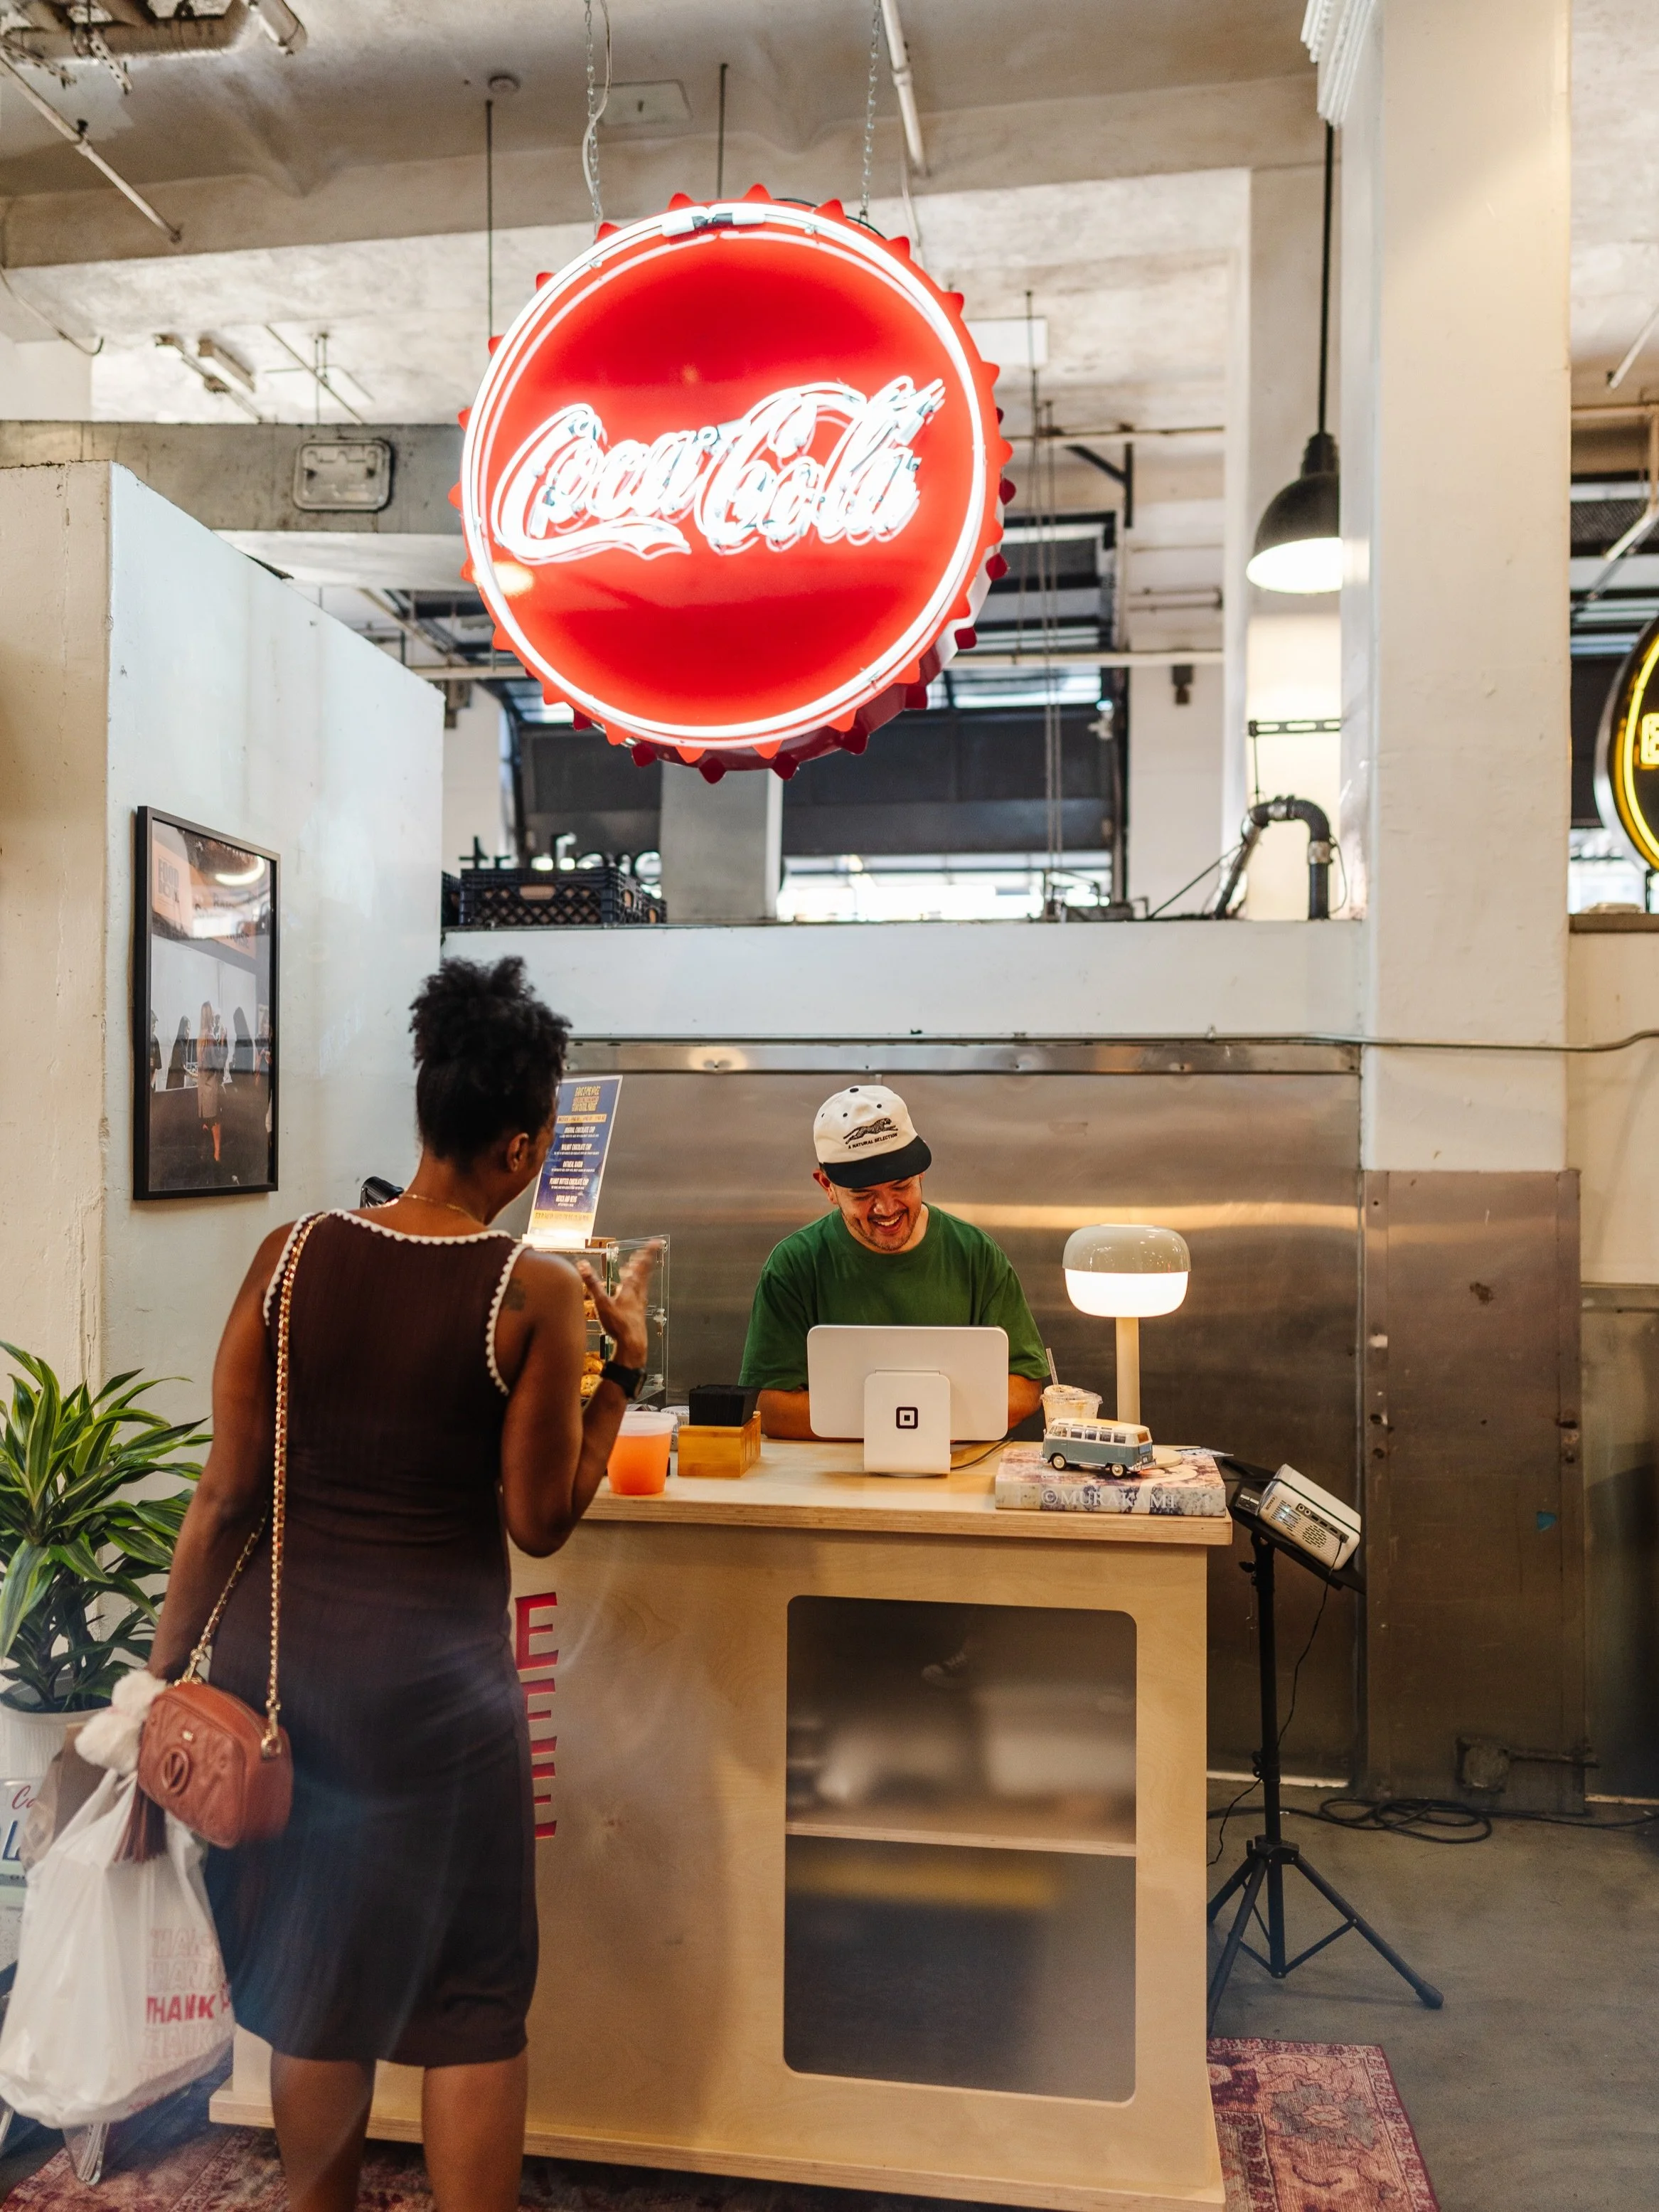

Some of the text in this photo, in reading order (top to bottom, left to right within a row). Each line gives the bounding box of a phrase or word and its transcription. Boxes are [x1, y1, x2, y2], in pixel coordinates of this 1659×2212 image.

[853, 1140, 874, 1149] NATURAL
[875, 1133, 897, 1142] SELECTION
[146, 1993, 215, 2024] THANK
